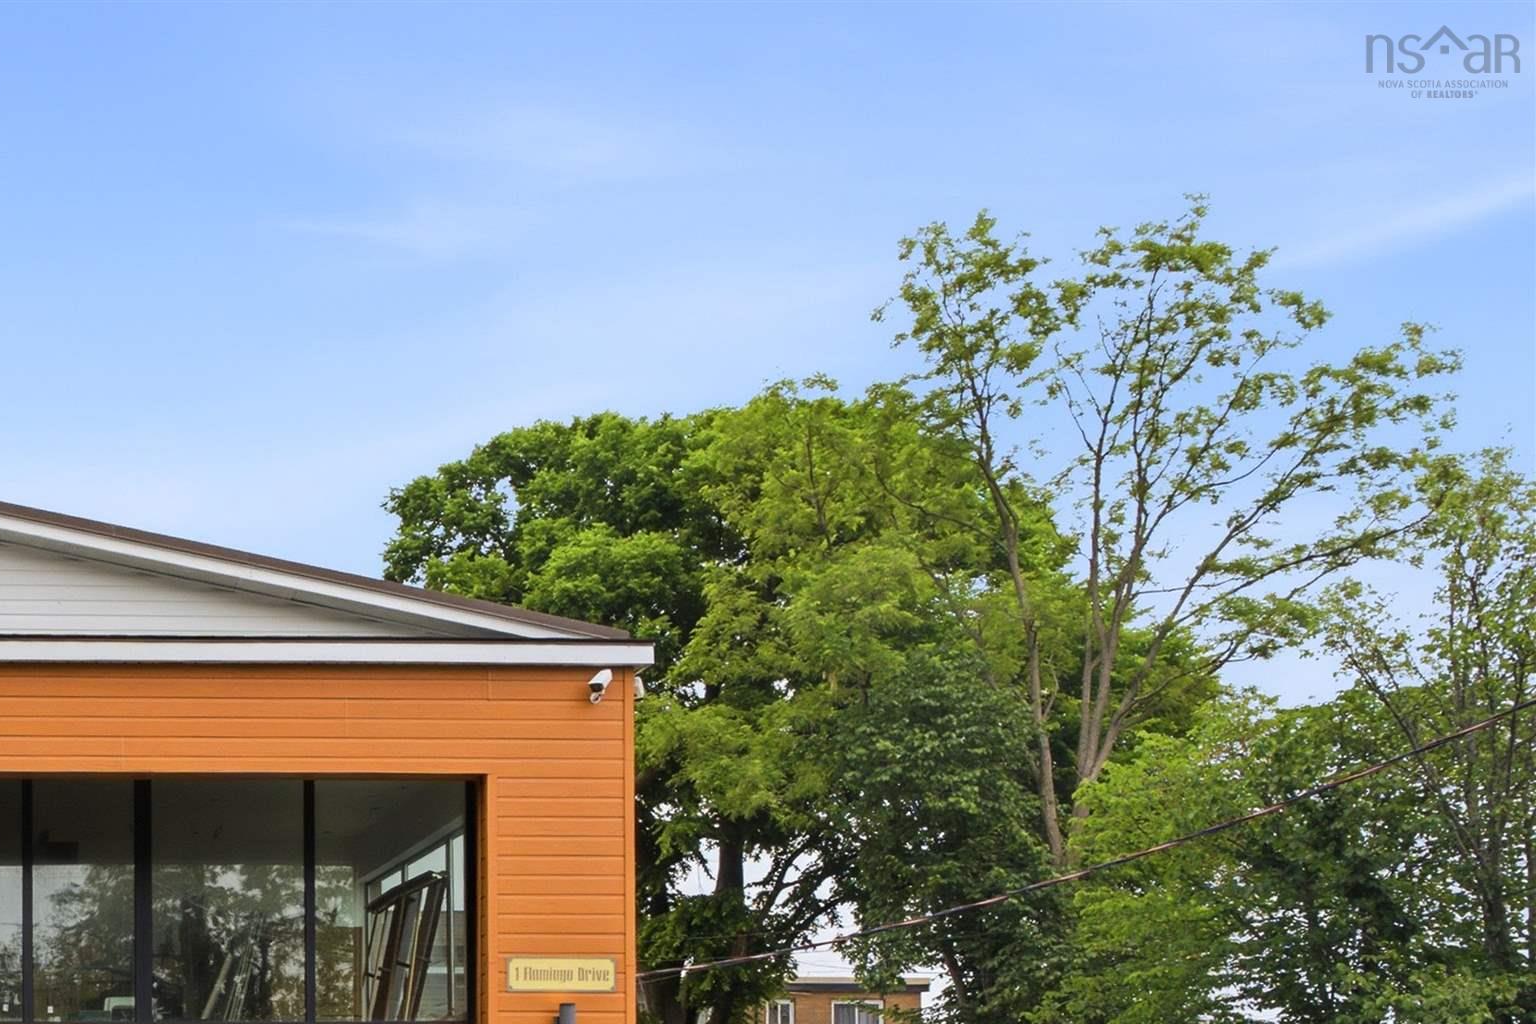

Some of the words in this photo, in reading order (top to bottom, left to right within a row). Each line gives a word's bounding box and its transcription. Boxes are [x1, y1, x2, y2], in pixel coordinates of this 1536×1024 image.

[514, 966, 520, 981] 1
[523, 966, 574, 983] Flamingo
[577, 966, 610, 982] Drive
